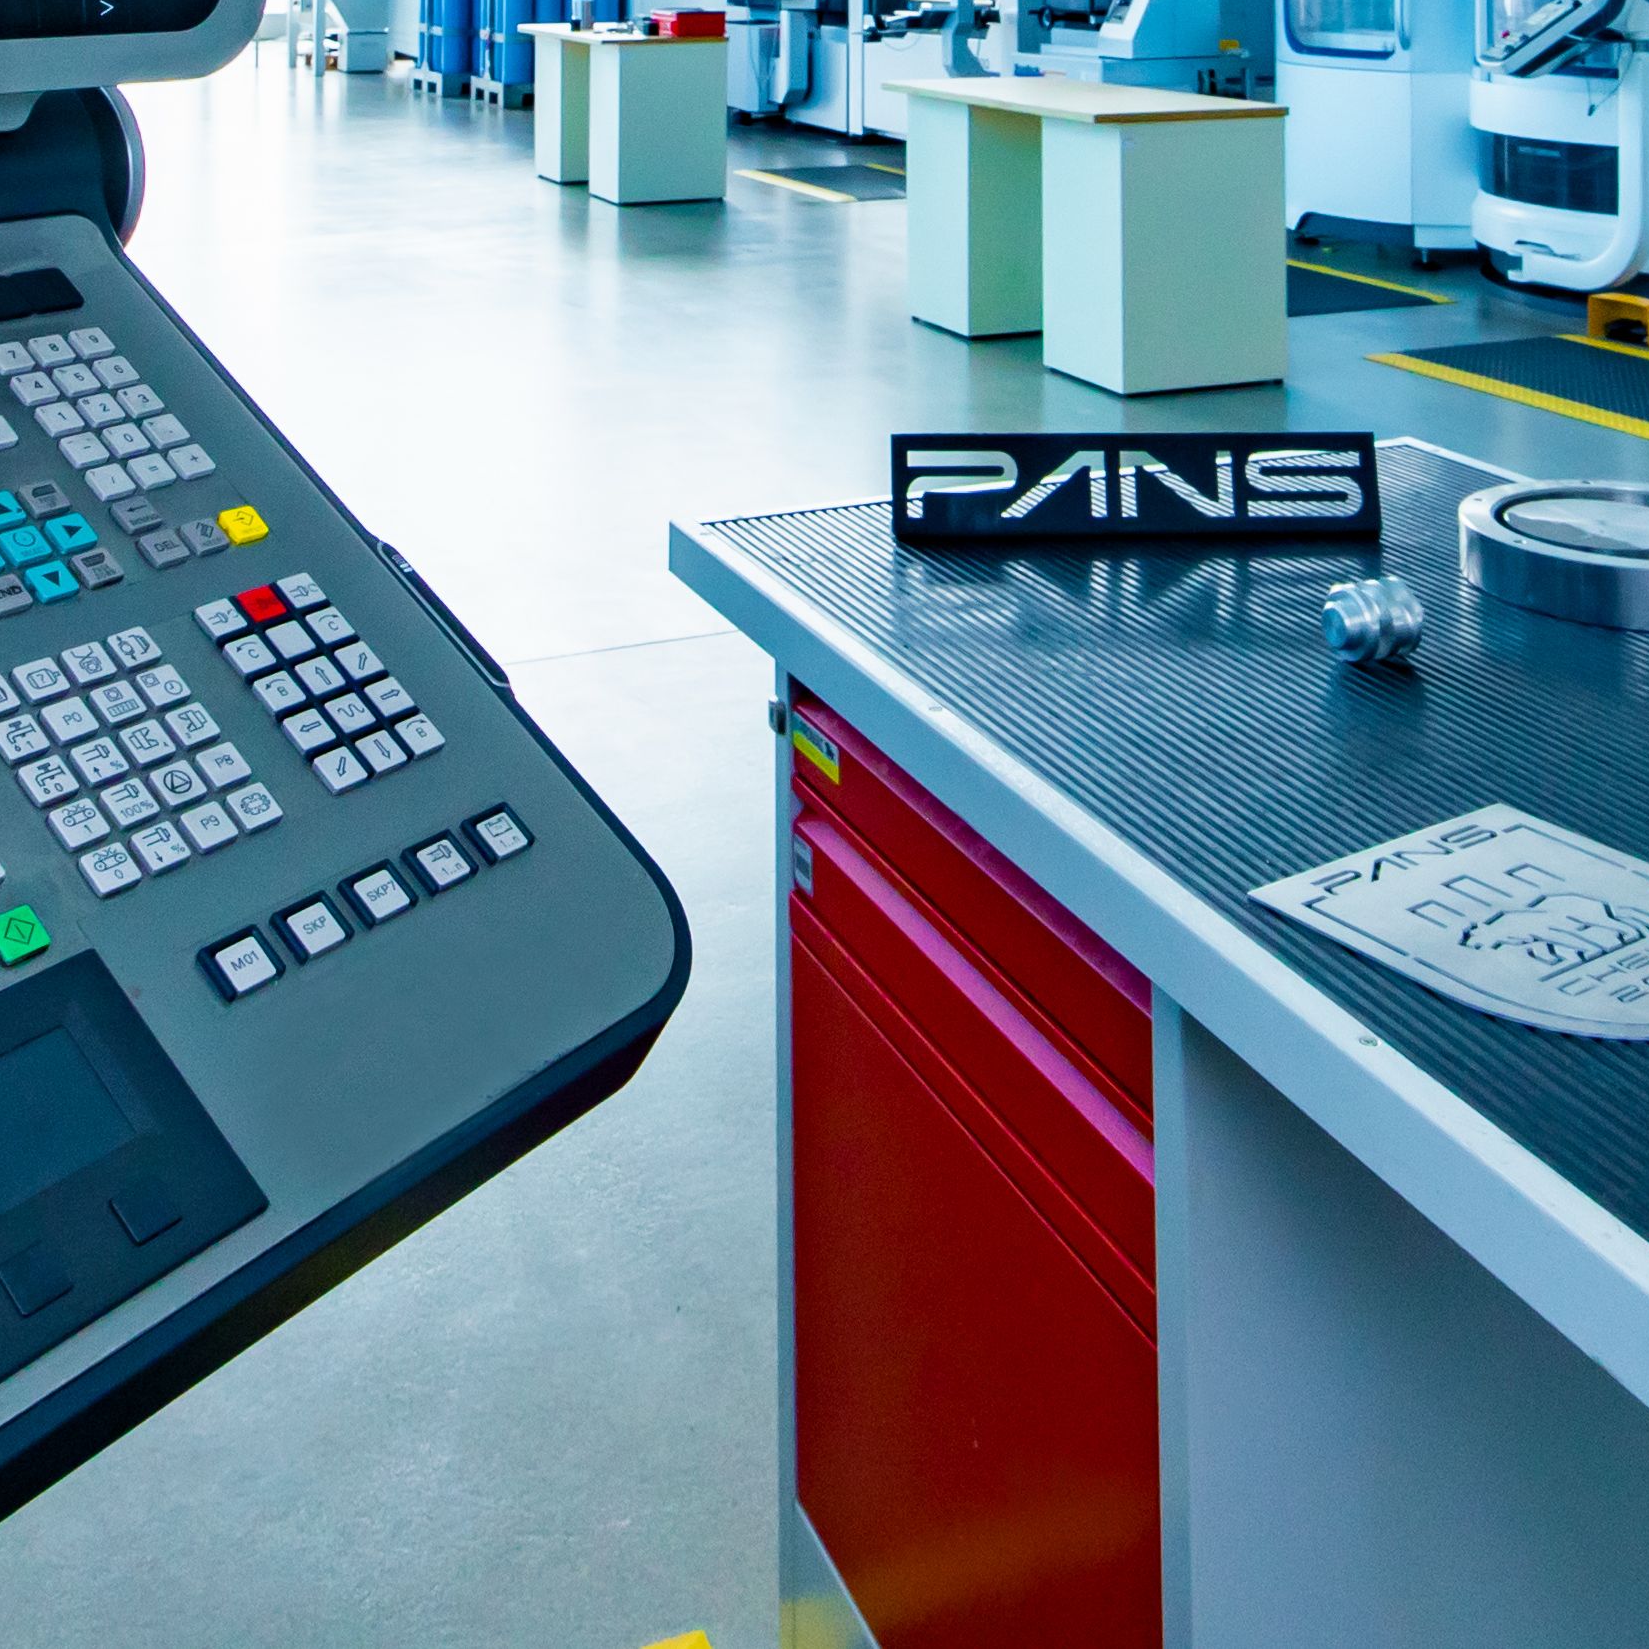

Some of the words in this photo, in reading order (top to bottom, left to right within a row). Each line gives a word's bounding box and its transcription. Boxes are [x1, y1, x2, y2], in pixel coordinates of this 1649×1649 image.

[905, 451, 1365, 519] PANS
[153, 540, 181, 553] DEL
[214, 754, 235, 768] P8
[120, 801, 155, 820] 100%
[200, 815, 221, 829] P9
[1310, 823, 1498, 894] PANS
[366, 881, 397, 902] SKP7
[303, 916, 328, 934] SKP
